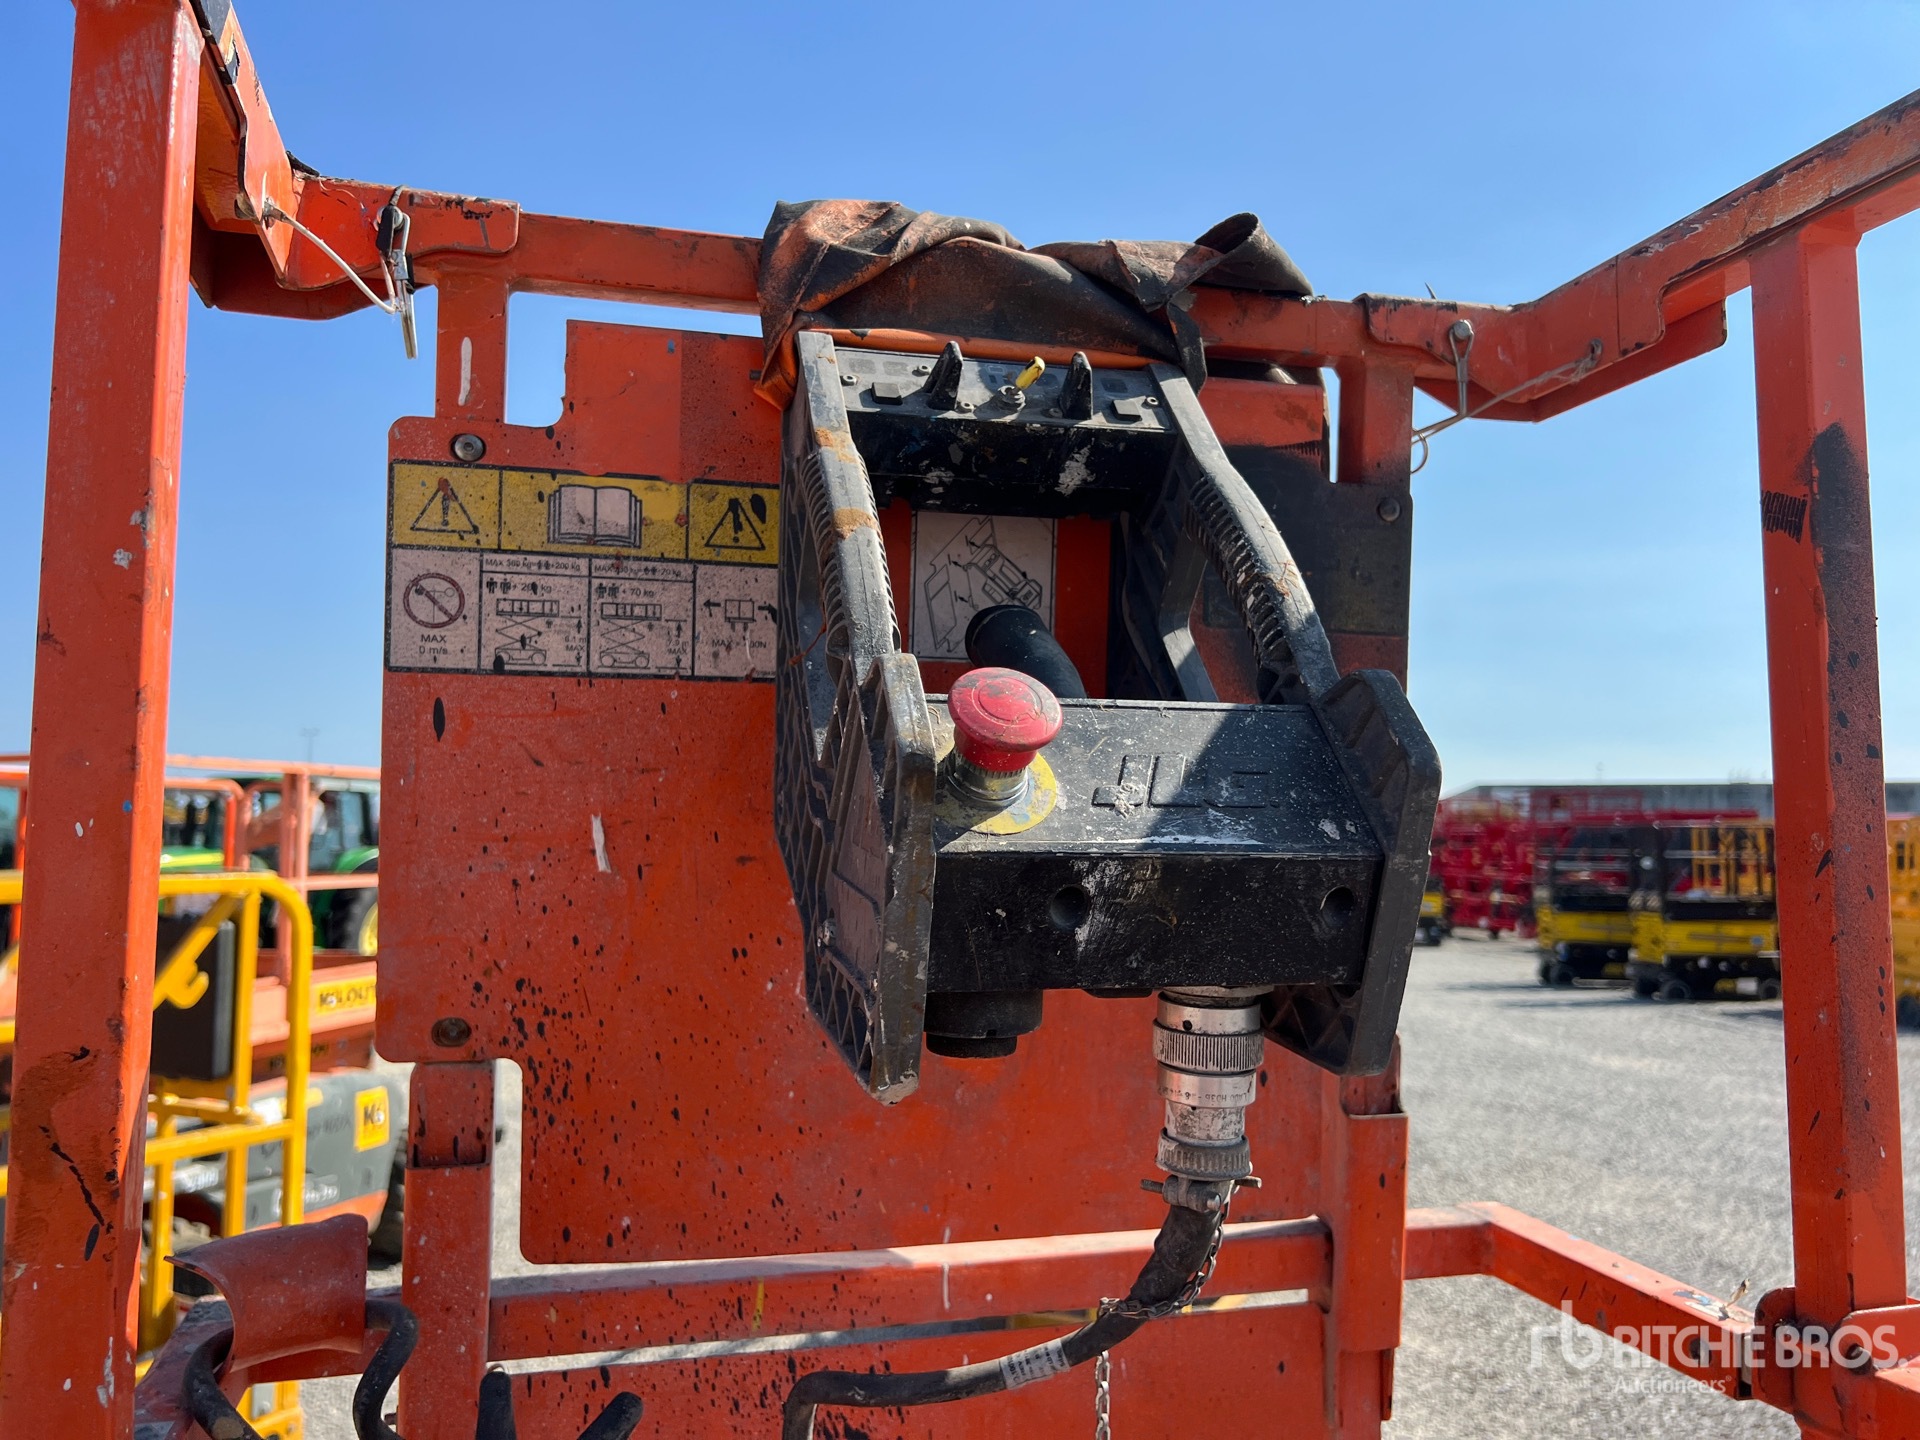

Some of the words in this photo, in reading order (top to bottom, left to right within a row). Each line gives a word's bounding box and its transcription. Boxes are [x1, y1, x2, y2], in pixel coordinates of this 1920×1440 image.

[521, 582, 539, 592] 20
[630, 587, 642, 597] 70
[420, 633, 448, 643] MAX
[565, 643, 586, 652] MAX
